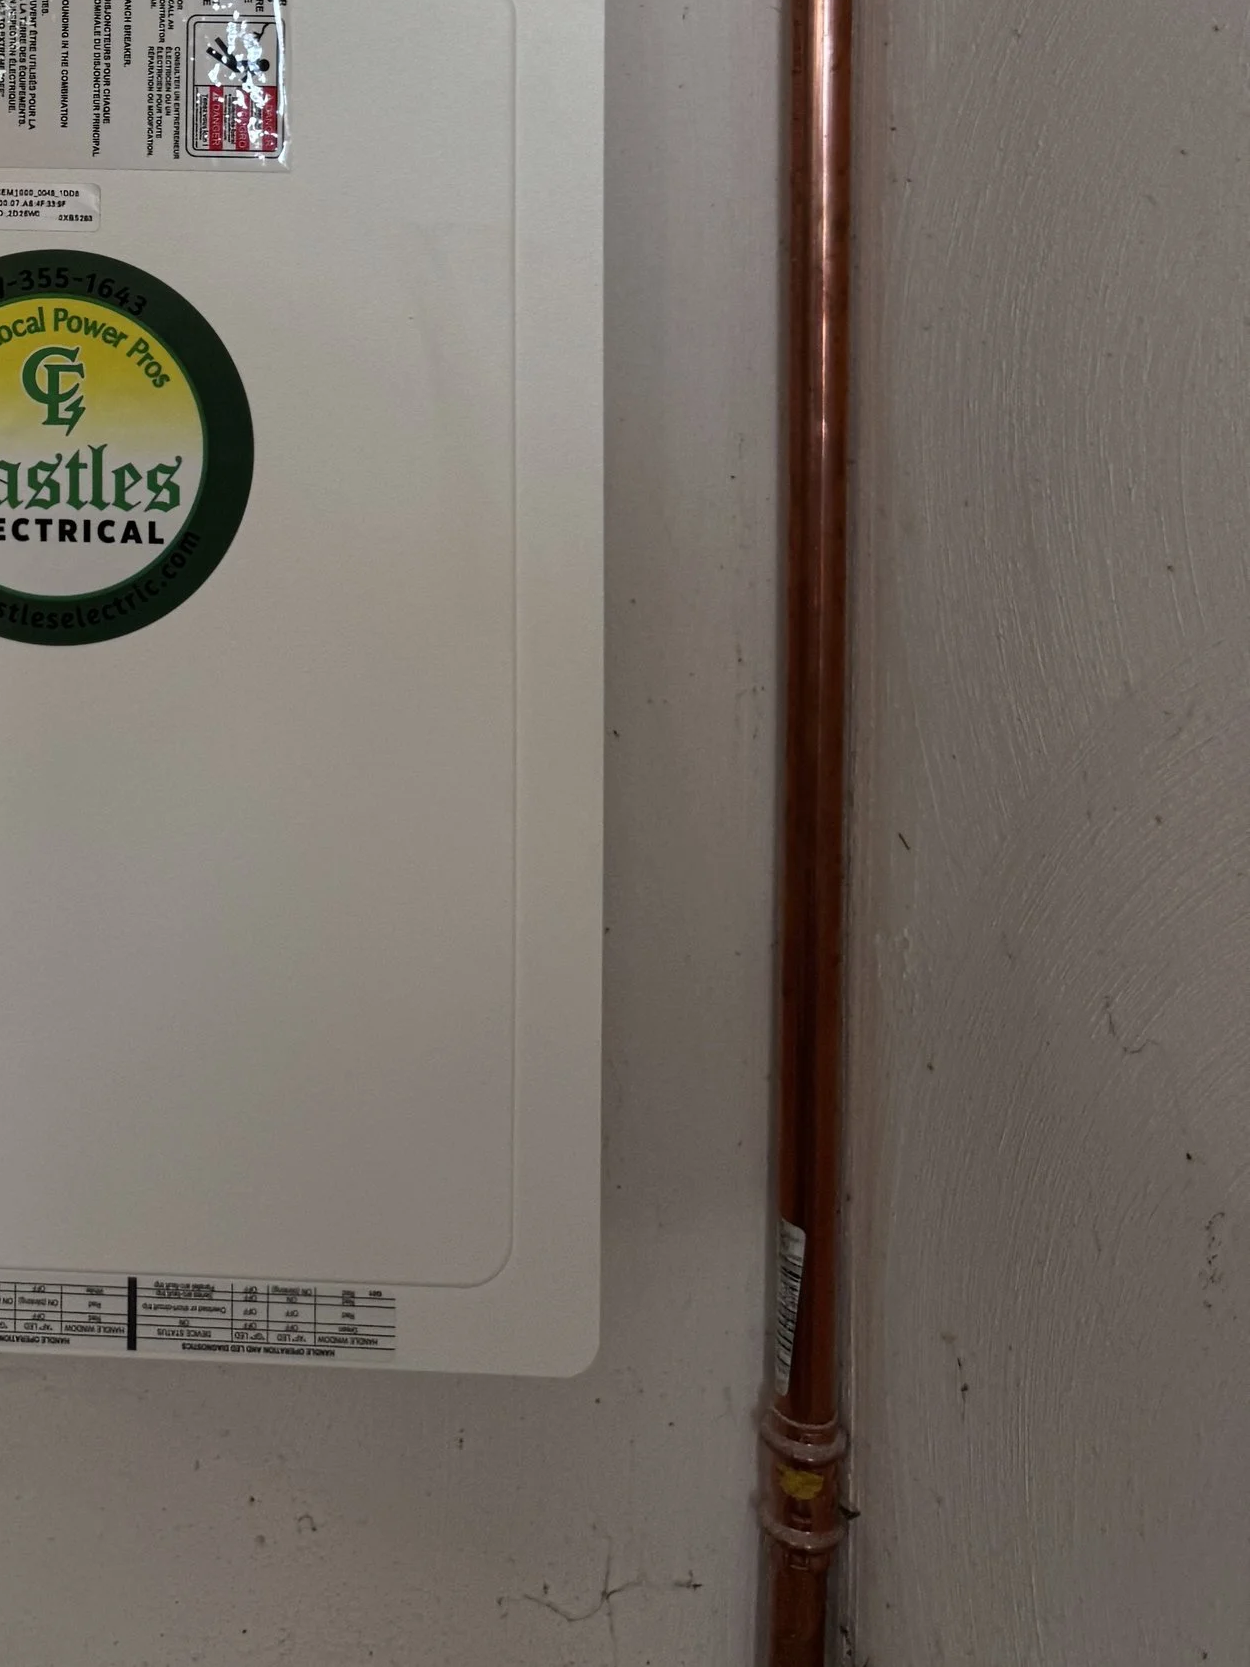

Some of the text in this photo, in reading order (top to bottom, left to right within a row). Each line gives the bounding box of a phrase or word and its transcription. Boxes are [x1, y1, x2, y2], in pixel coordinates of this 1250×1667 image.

[212, 103, 221, 146] DANGER
[53, 308, 129, 348] Power
[126, 337, 171, 388] Pros
[187, 1328, 211, 1337] DEVICE
[246, 1346, 335, 1357] HANDLE AND
